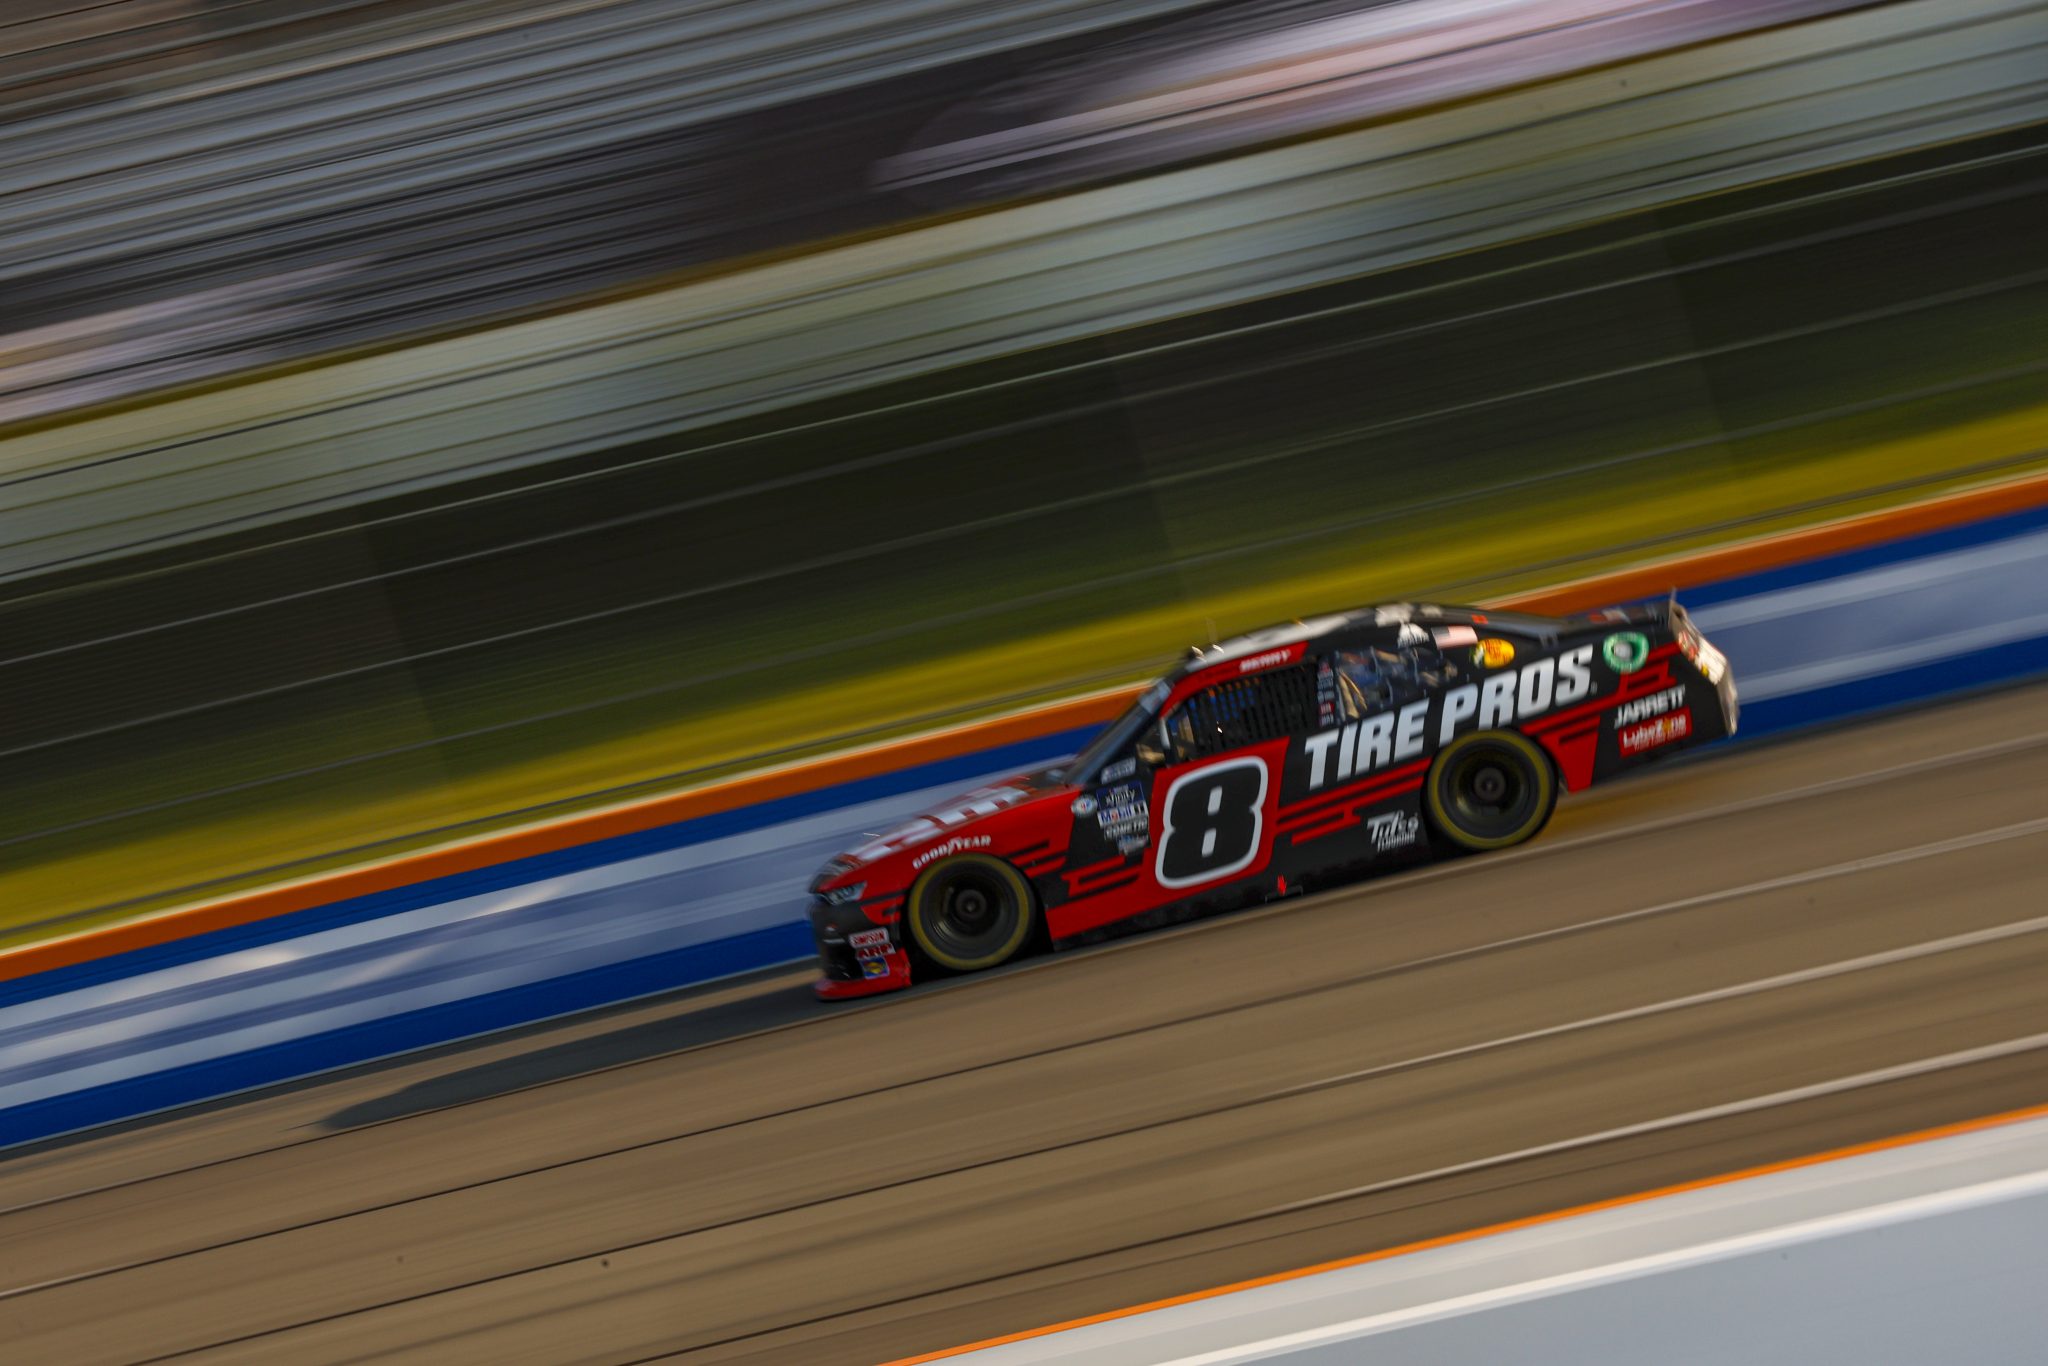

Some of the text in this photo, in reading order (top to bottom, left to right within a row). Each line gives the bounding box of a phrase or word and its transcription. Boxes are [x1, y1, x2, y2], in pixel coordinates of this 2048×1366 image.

[1304, 699, 1429, 791] TIRE
[1438, 645, 1594, 748] PROS
[1614, 684, 1686, 730] JARRETT
[1100, 803, 1133, 826] Mobil
[1155, 755, 1269, 889] 8
[912, 834, 992, 870] GOODYEAR
